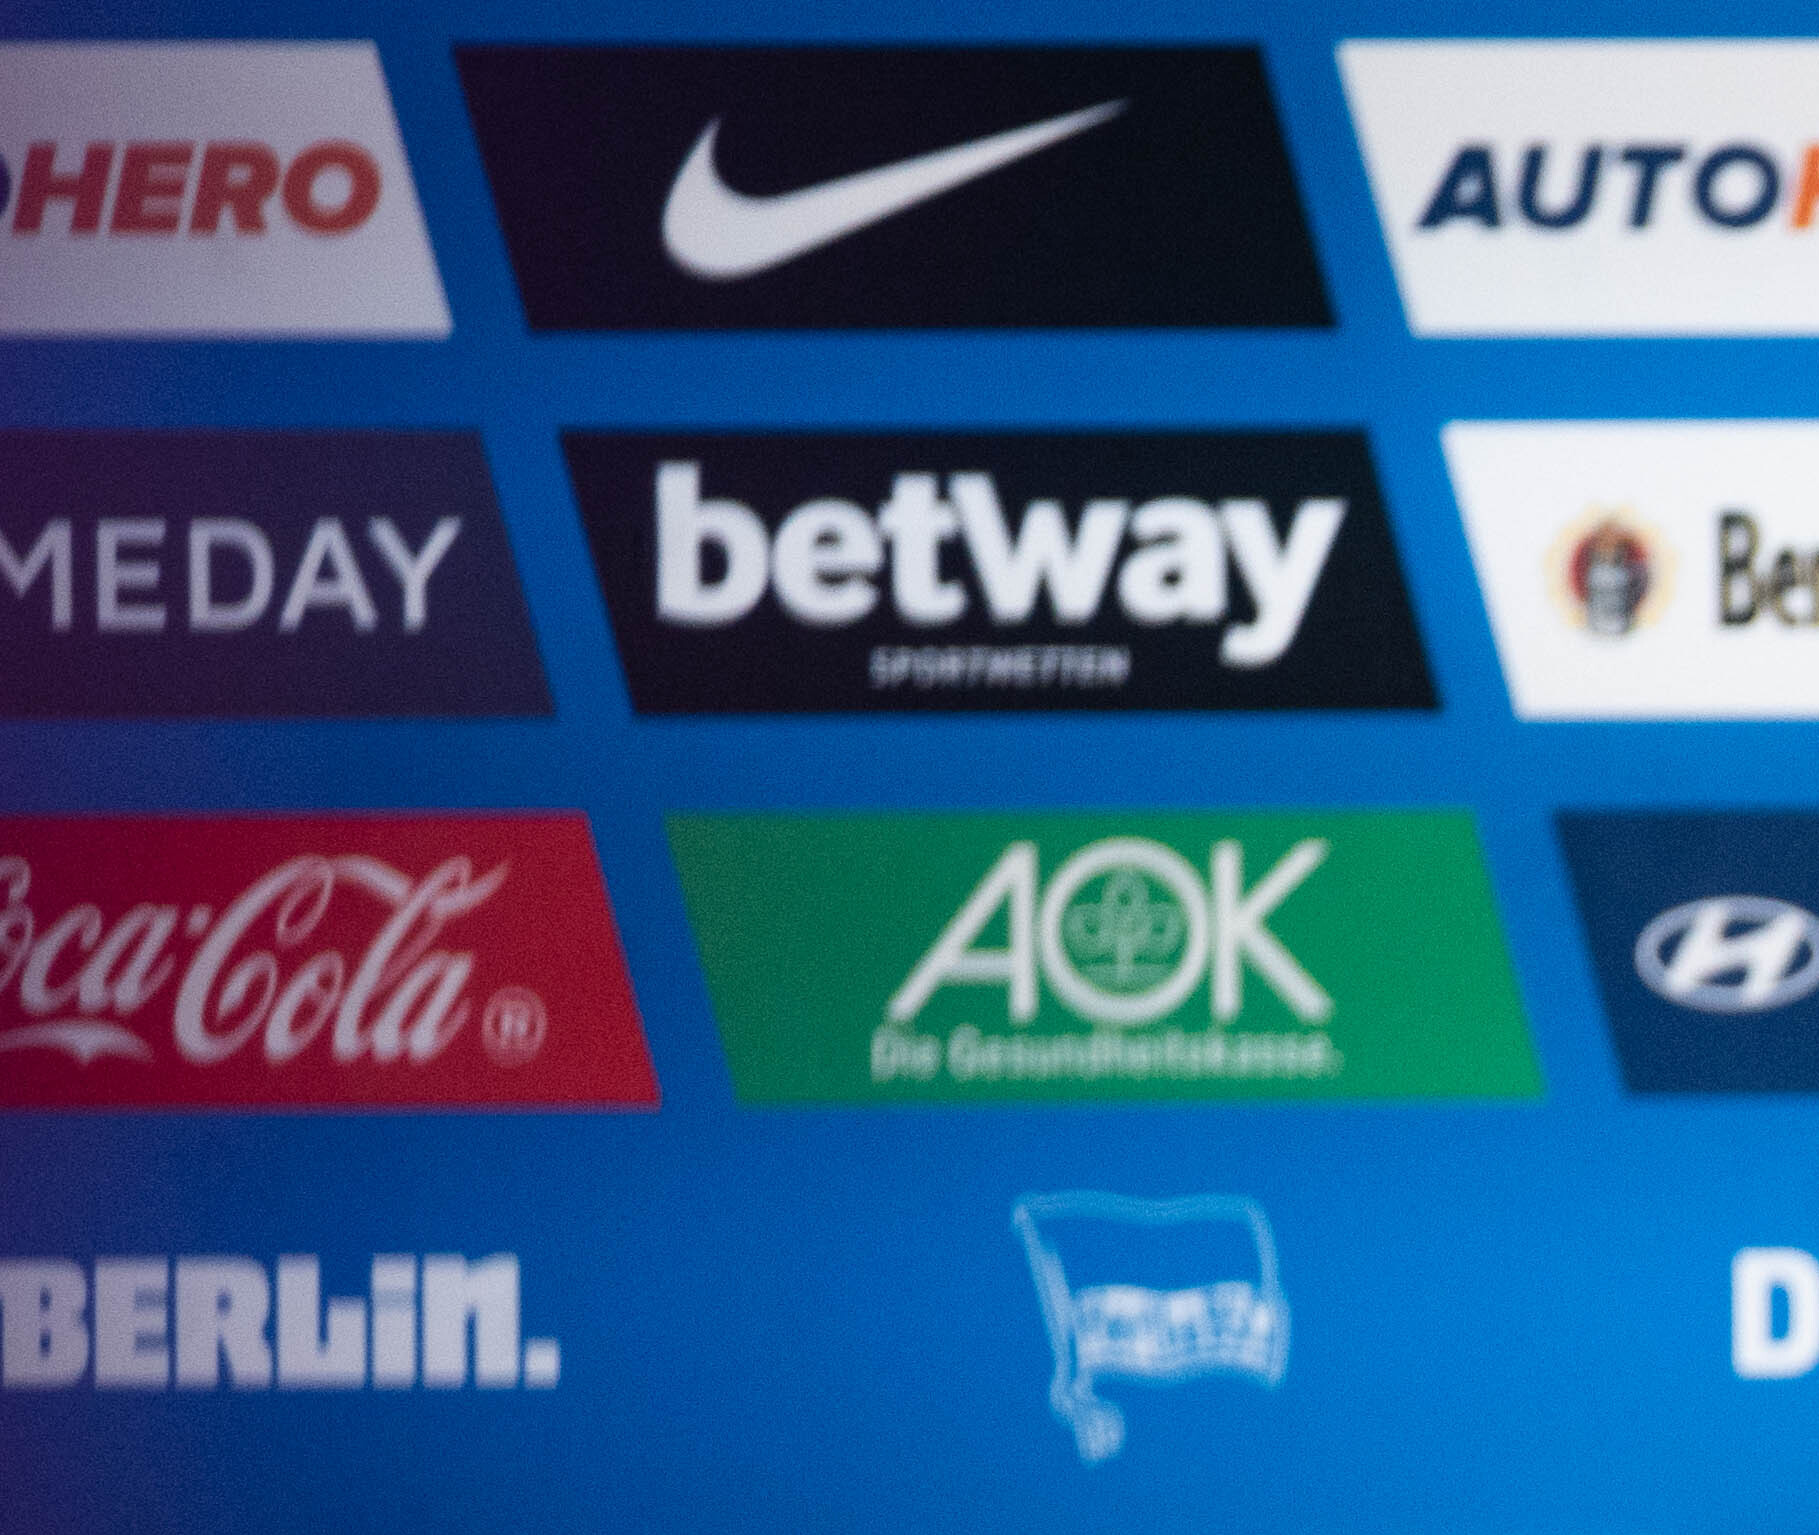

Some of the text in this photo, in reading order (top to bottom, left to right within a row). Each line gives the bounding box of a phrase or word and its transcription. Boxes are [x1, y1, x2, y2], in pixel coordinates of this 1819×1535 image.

[0, 140, 381, 237] HERO
[656, 462, 1347, 668] betway
[888, 836, 1334, 1025] AOK
[870, 1026, 941, 1082] Die
